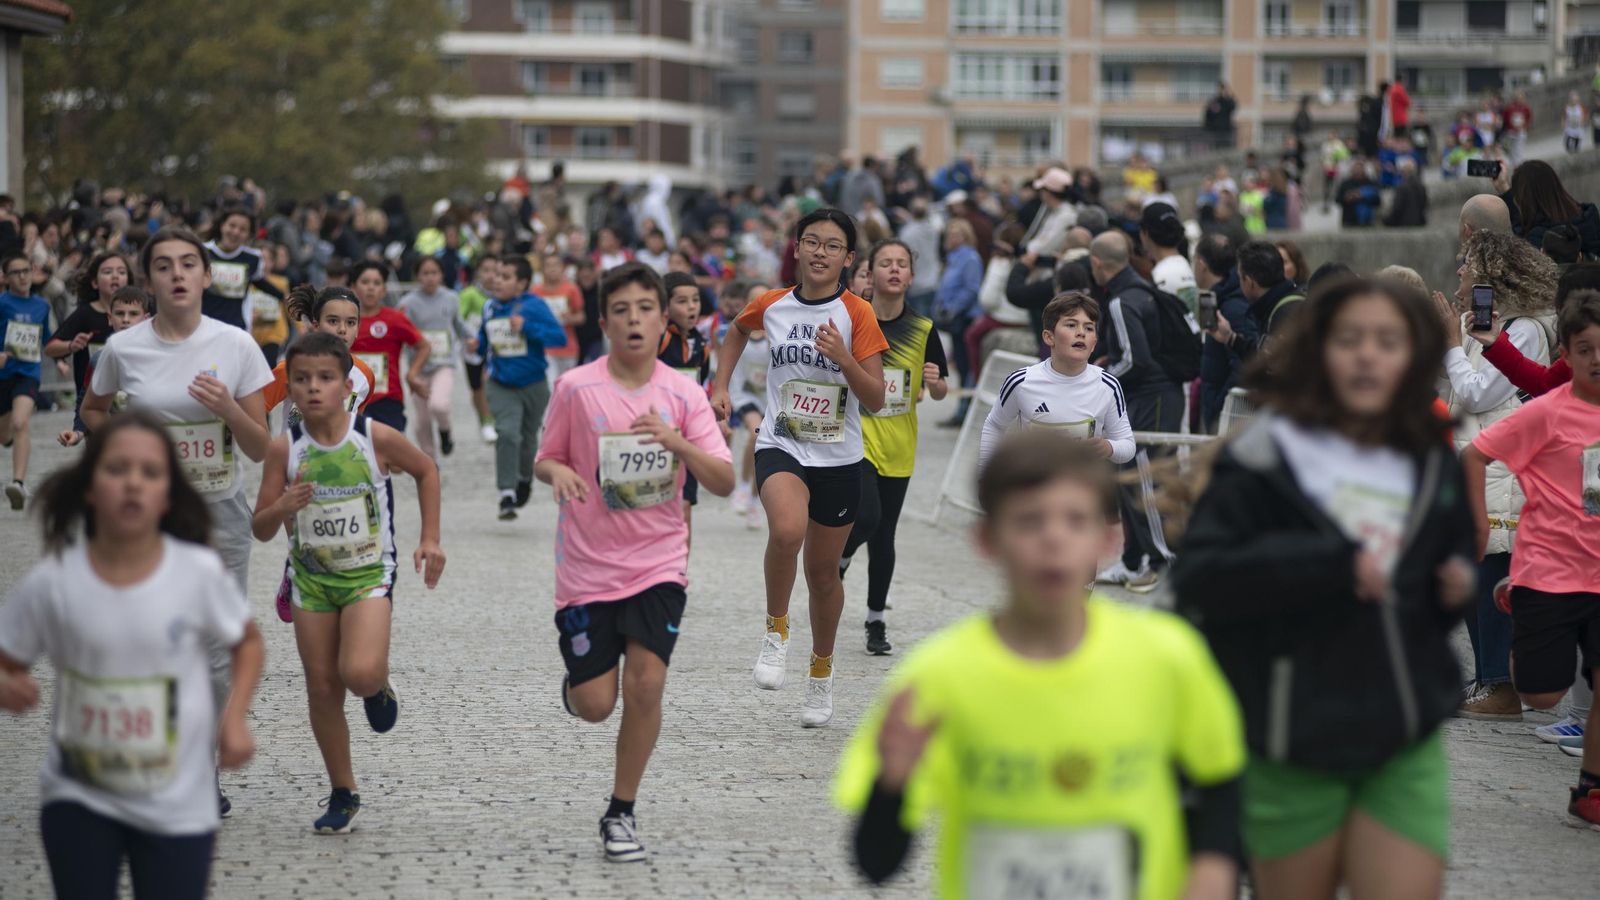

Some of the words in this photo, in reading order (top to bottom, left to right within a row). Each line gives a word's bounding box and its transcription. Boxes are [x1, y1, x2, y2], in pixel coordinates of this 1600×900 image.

[787, 324, 817, 340] AN
[793, 393, 831, 415] 7472
[619, 449, 668, 473] 7995
[313, 515, 360, 538] 8076
[81, 704, 154, 741] 7138
